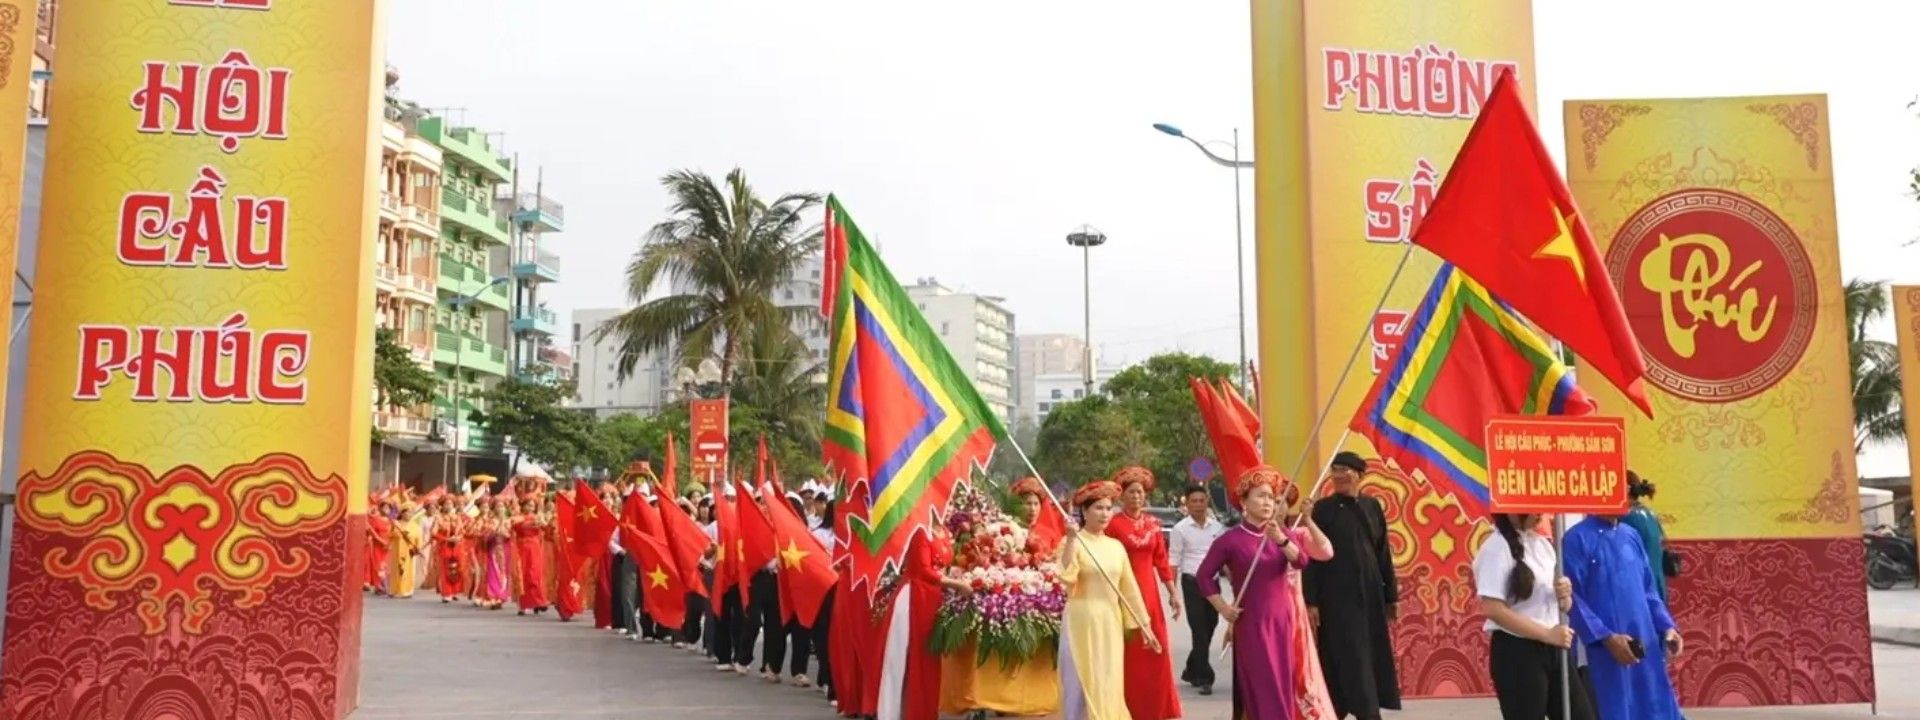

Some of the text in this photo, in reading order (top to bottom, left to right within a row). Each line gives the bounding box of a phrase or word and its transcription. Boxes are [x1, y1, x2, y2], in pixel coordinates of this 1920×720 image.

[130, 49, 292, 152] HỘI
[116, 166, 288, 270] CẦU
[1364, 157, 1438, 243] SẦ
[1640, 232, 1777, 358] Phúc
[73, 313, 310, 403] PHÚC
[1529, 462, 1566, 496] LÀNG
[1569, 463, 1589, 497] CÁ
[1591, 463, 1618, 503] LẬP
